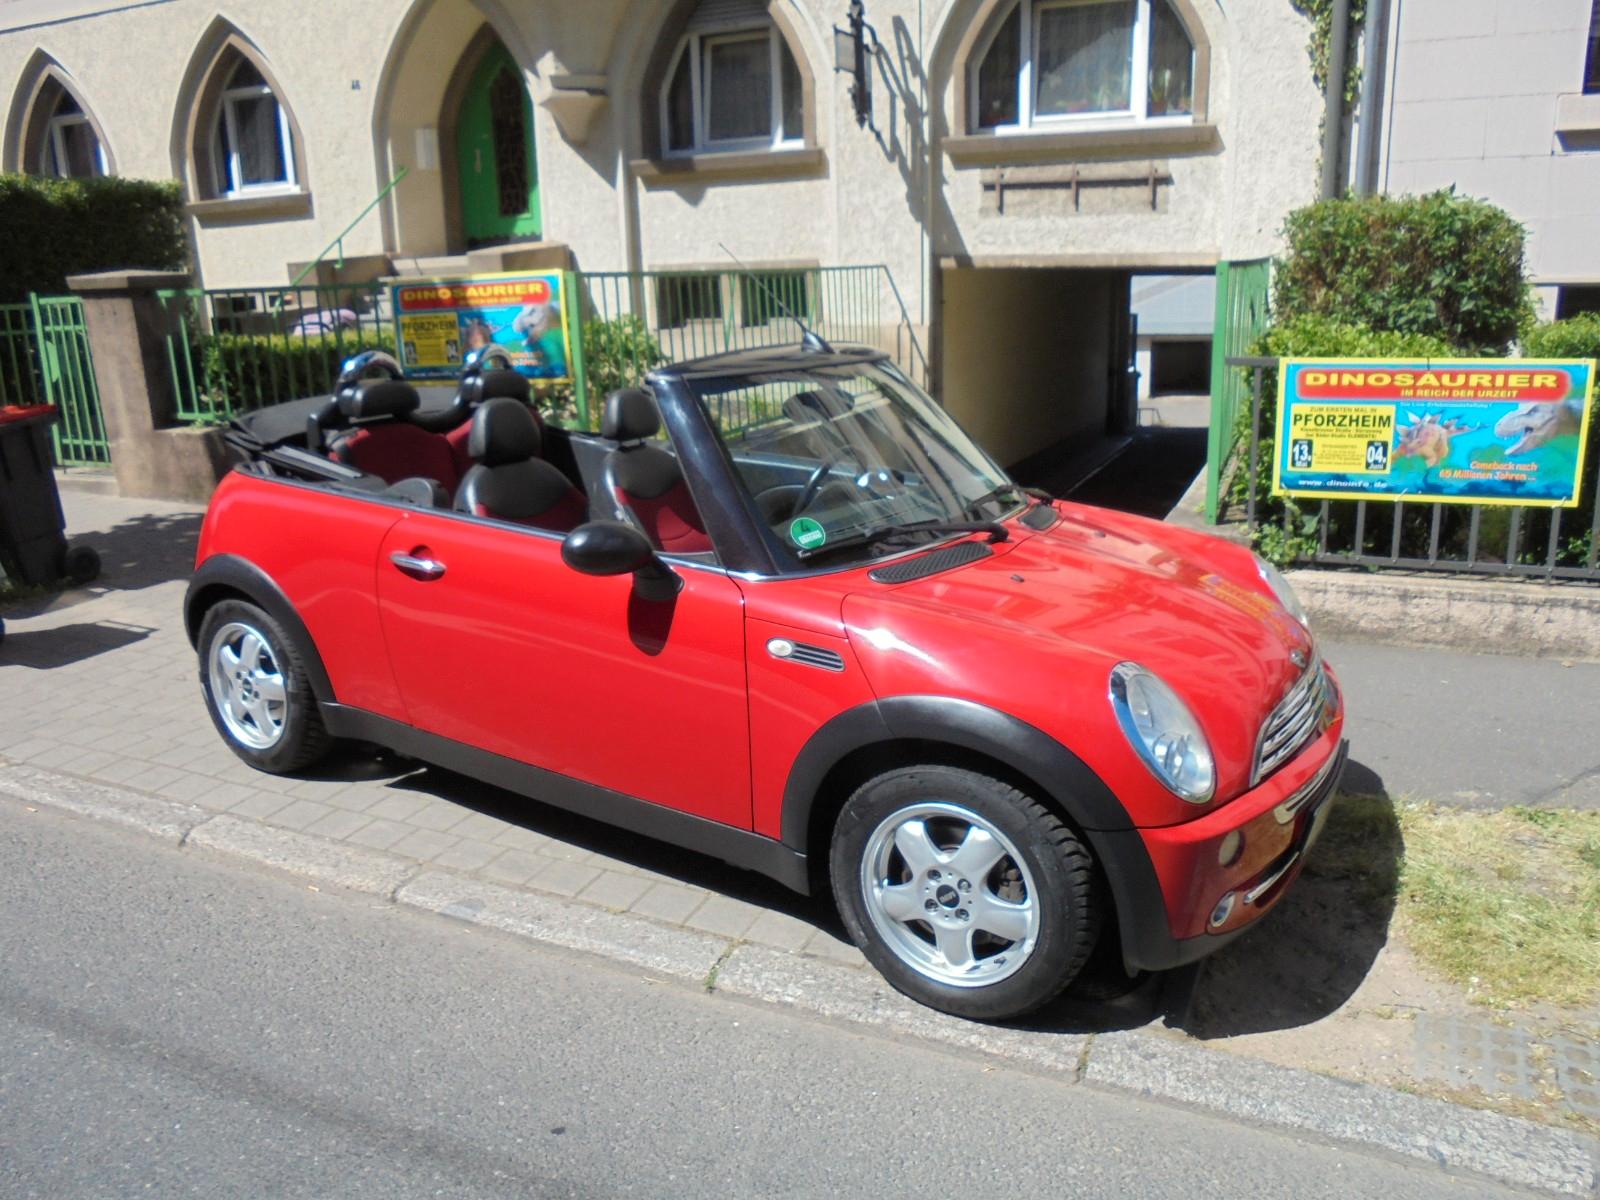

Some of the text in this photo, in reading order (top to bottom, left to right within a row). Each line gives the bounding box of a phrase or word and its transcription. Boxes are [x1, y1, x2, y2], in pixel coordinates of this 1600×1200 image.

[403, 283, 543, 301] DINOSAURIER
[1305, 372, 1558, 388] DINOSAURIER
[1400, 389, 1519, 399] IM REICH DER URZEIT
[1293, 414, 1392, 428] PFORZHEIM
[1293, 444, 1311, 462] 13.
[1367, 445, 1387, 463] 04.
[1470, 461, 1538, 471] Comeback nach
[1454, 470, 1493, 479] Millionen
